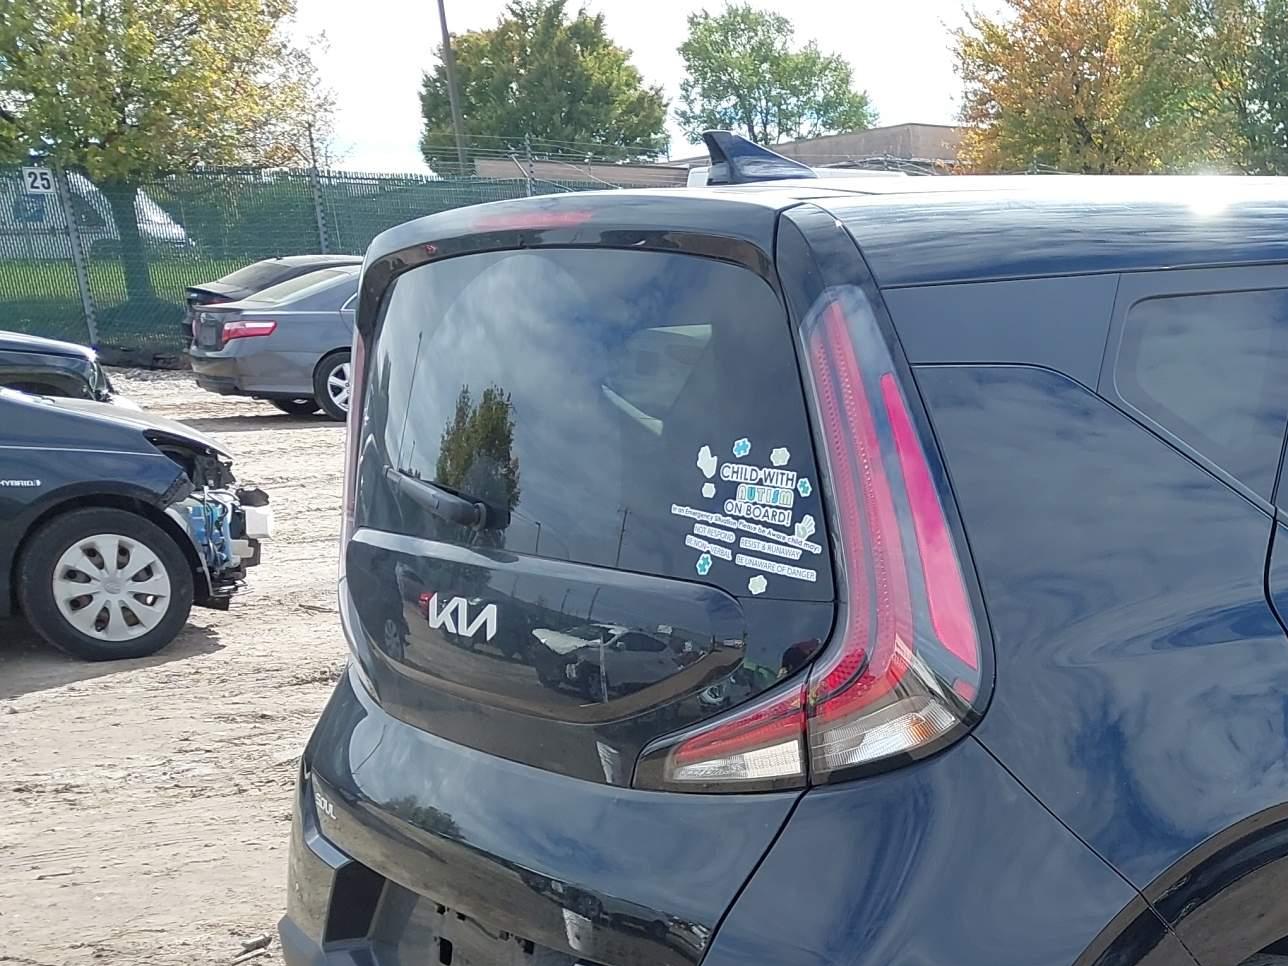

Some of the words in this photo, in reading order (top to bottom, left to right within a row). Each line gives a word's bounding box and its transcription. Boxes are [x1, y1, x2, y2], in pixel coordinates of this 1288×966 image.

[27, 171, 51, 190] 25
[721, 464, 759, 482] CHILD
[763, 469, 796, 488] WITH
[737, 485, 792, 506] AUTISM
[685, 507, 714, 522] Emergency
[738, 520, 757, 532] Please
[766, 529, 787, 541] Aware
[725, 500, 743, 514] ON
[745, 504, 791, 526] BOARD!
[740, 539, 760, 550] RESIST
[766, 544, 801, 559] RUNAWAY
[745, 557, 776, 572] UNAWARE
[776, 564, 786, 574] OF
[786, 567, 815, 580] DANGER
[428, 592, 497, 641] KIA
[315, 792, 337, 820] SOUL
